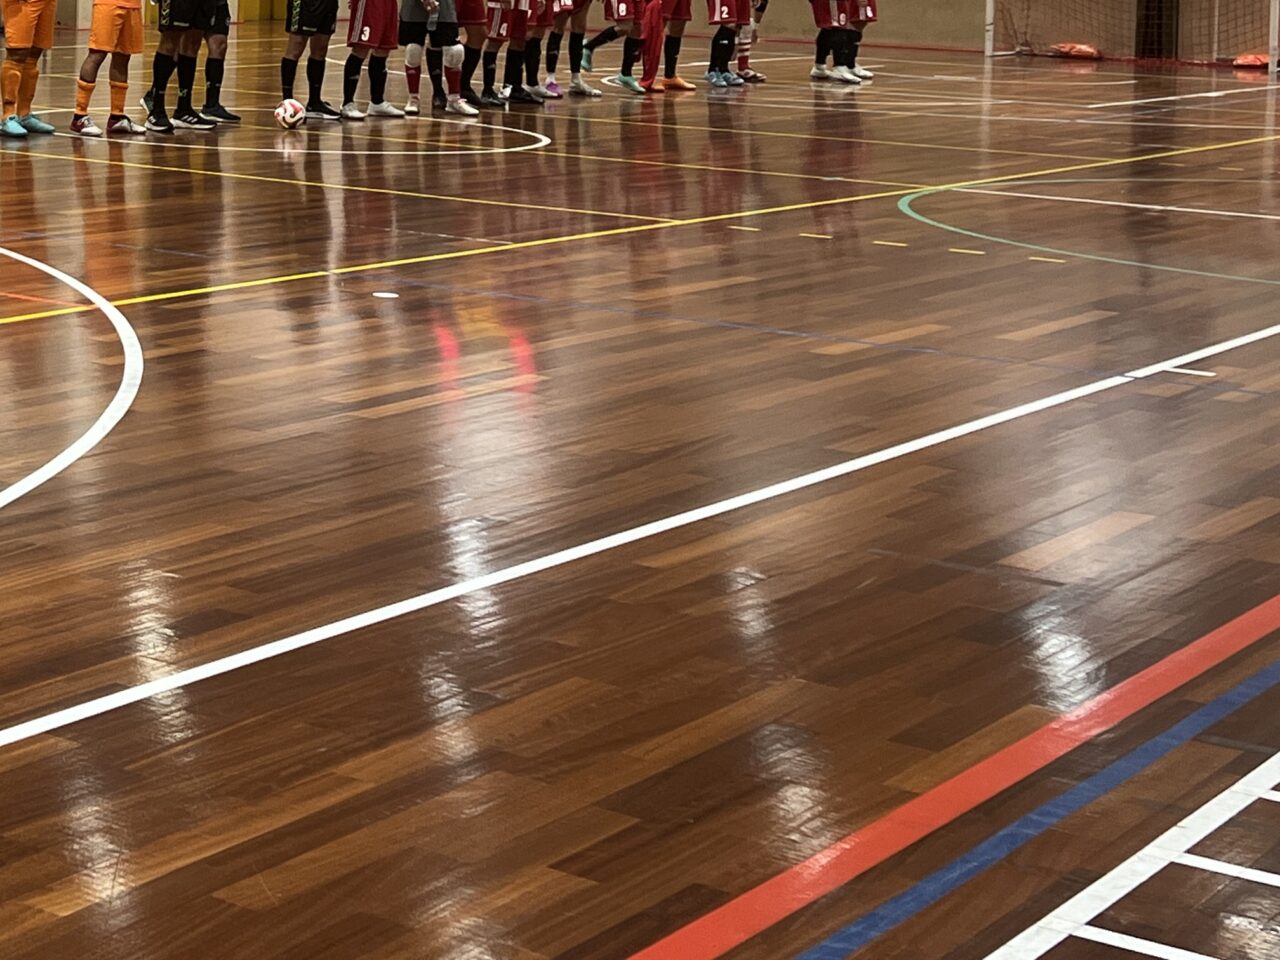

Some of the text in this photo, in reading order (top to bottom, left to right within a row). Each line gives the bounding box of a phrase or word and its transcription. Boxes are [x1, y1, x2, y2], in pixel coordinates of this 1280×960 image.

[619, 3, 627, 16] 8
[721, 6, 729, 18] 2
[361, 26, 370, 41] 3
[499, 23, 508, 37] 4
